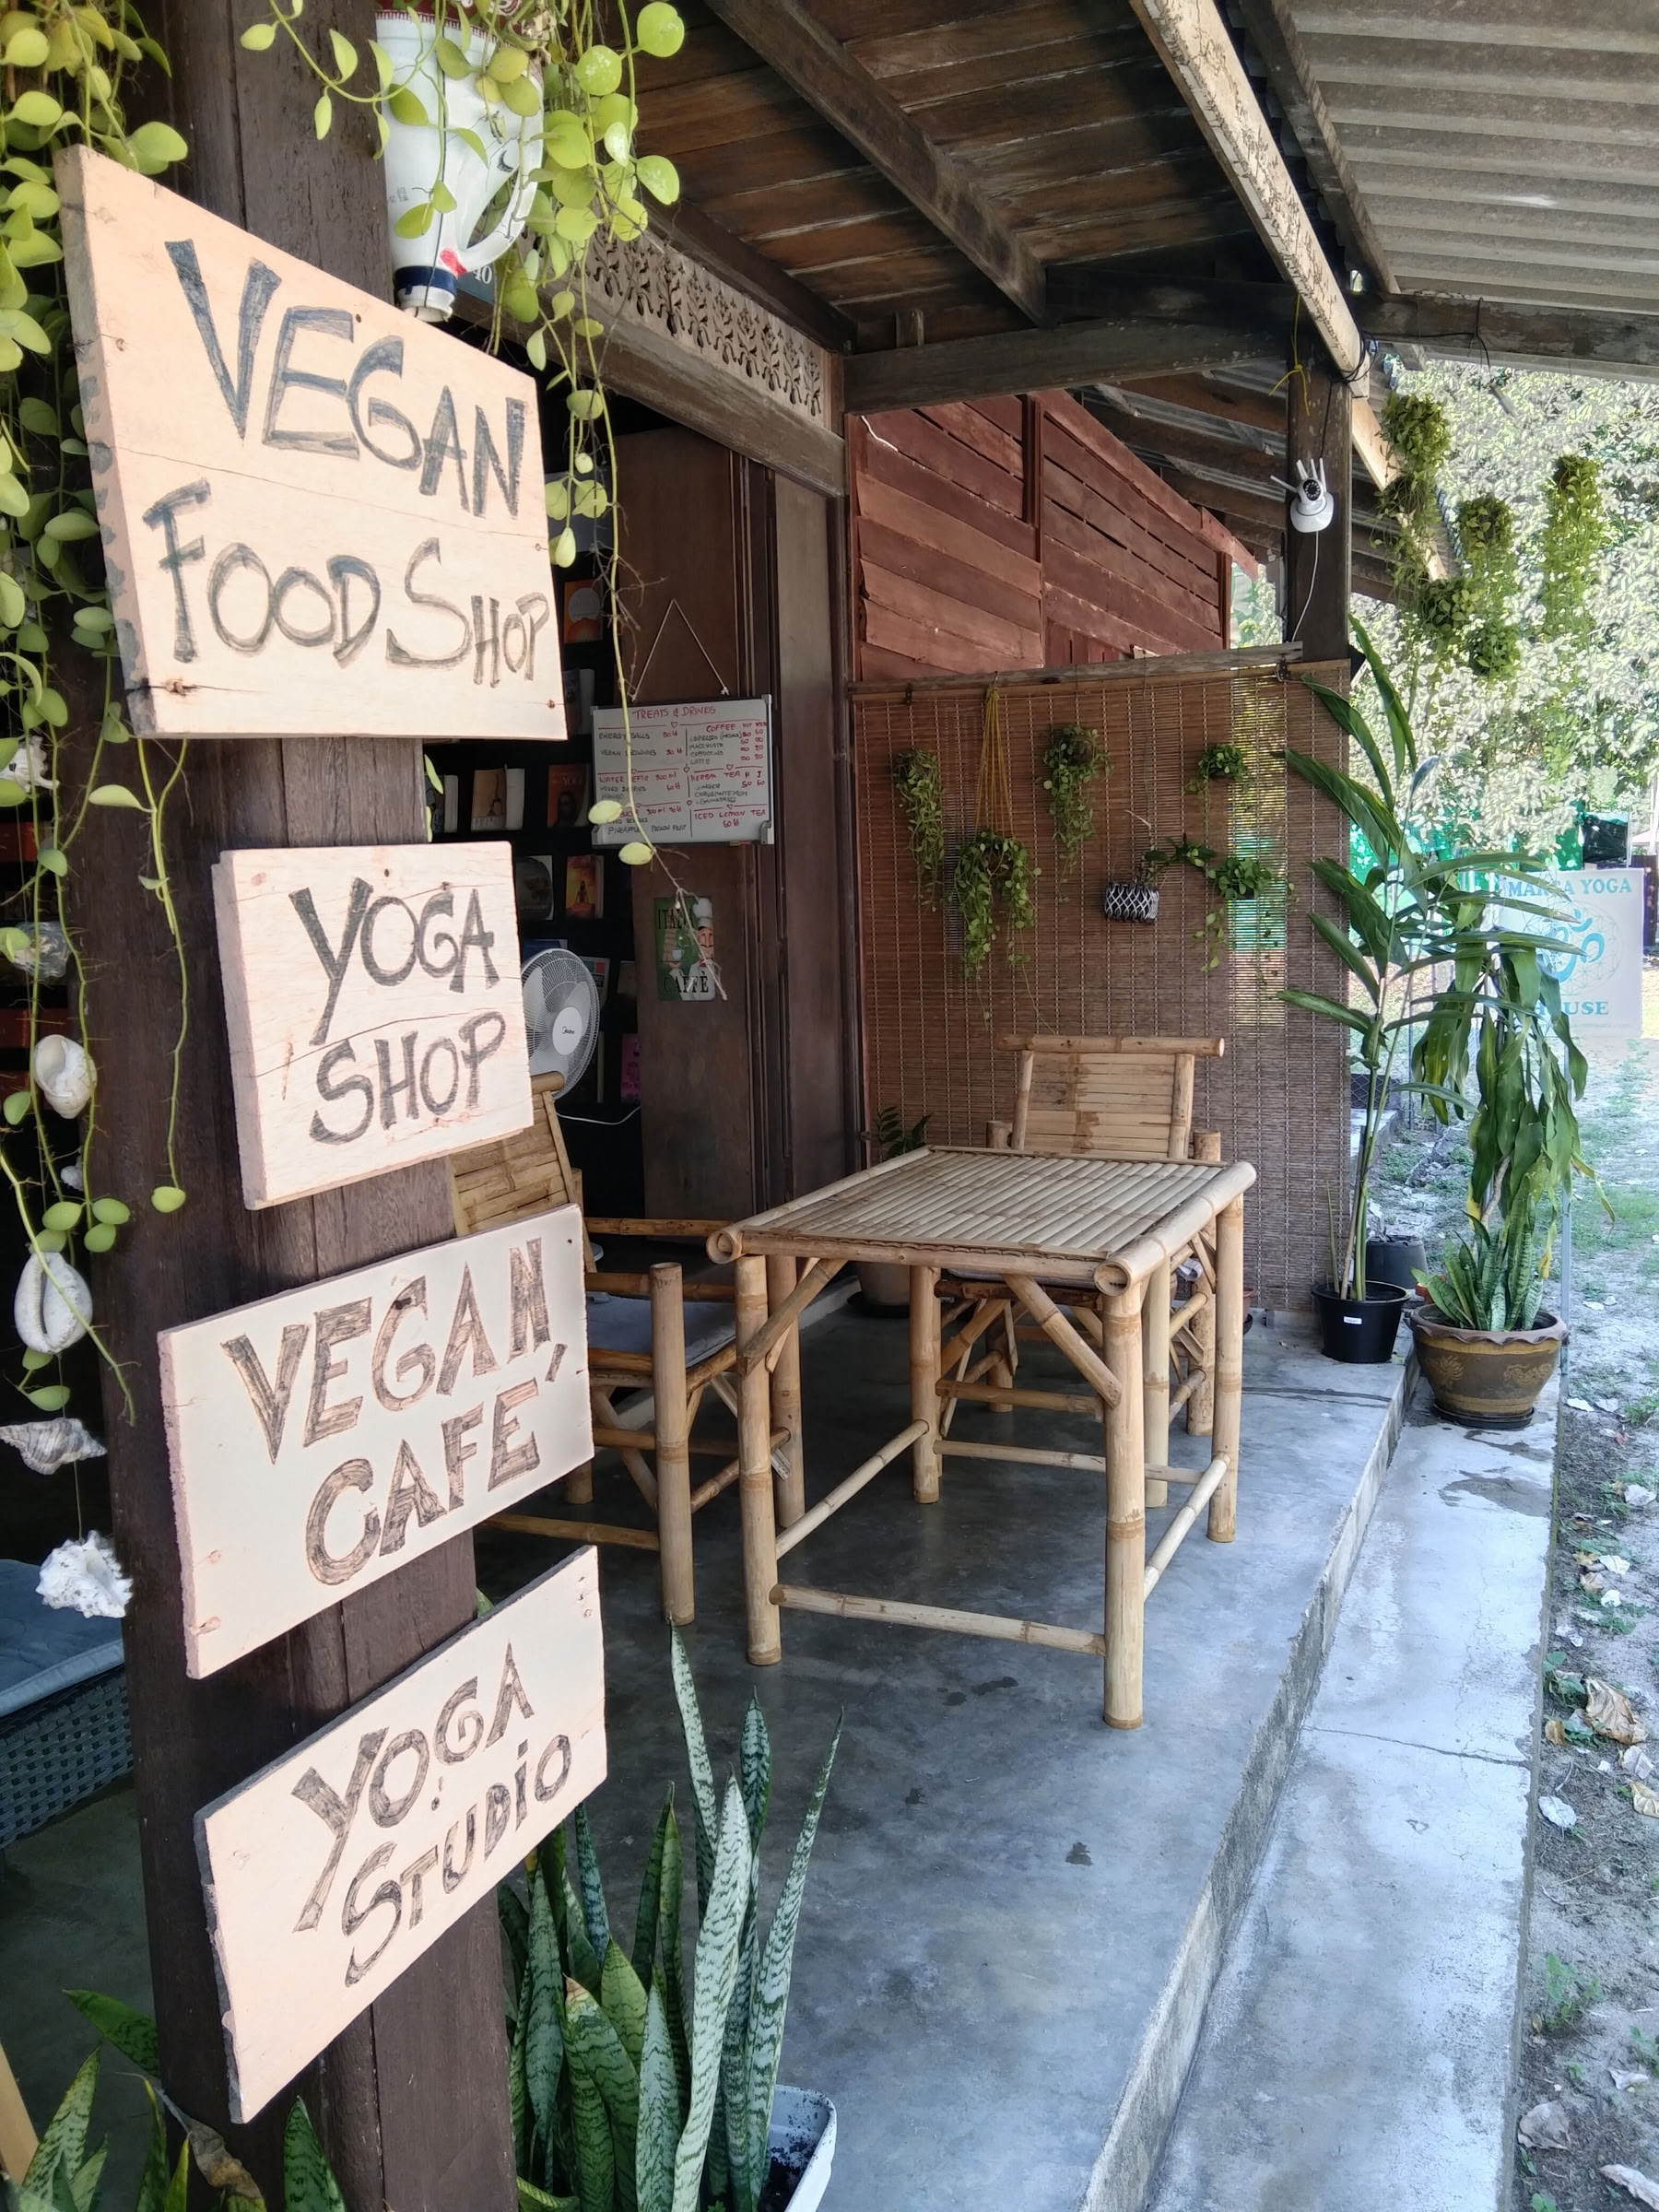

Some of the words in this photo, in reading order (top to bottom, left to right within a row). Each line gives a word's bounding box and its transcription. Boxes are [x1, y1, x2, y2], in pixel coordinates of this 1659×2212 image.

[164, 239, 528, 520] VEGAN
[143, 477, 382, 669] FOOD
[385, 537, 548, 688] SHOP
[632, 707, 669, 720] TREATS
[681, 706, 716, 717] DRINKS
[706, 724, 735, 732] COFFEE
[1580, 877, 1632, 894] YOGA
[288, 877, 500, 1046] YOGA
[309, 1011, 506, 1145] SHOP
[291, 1637, 535, 1933] YOGA
